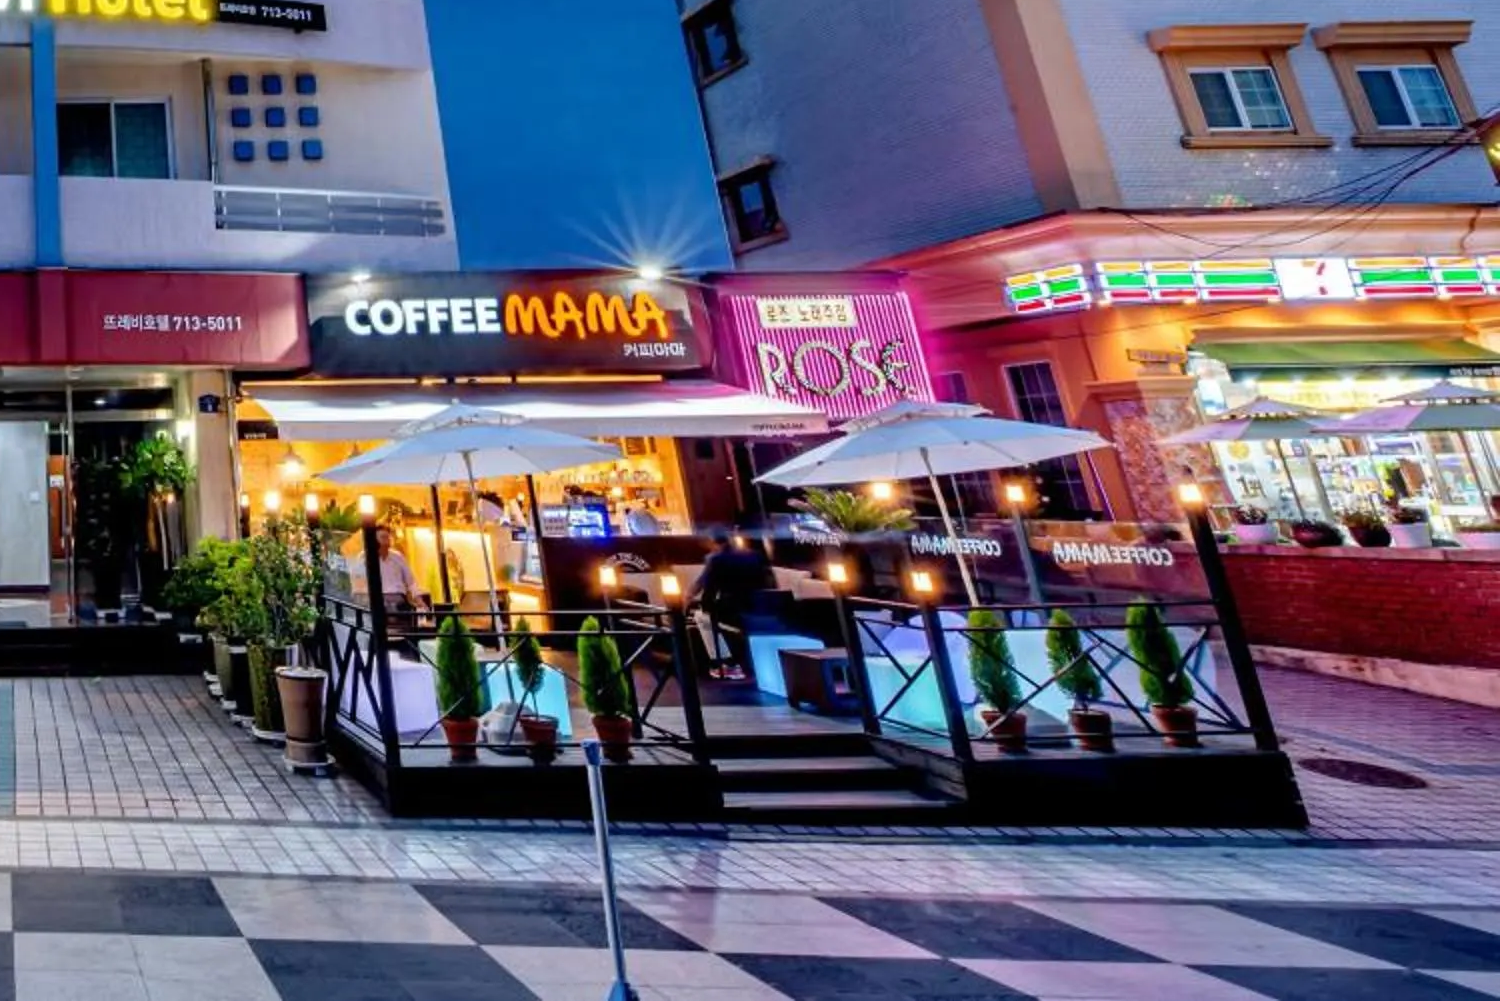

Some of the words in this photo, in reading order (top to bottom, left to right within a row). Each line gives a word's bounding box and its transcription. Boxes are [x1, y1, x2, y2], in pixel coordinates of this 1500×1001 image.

[103, 314, 171, 332] 뜨레비호텔
[173, 315, 243, 332] 713-5011
[344, 297, 500, 336] COFFEE
[503, 290, 669, 340] MAMA
[756, 338, 916, 399] ROSE
